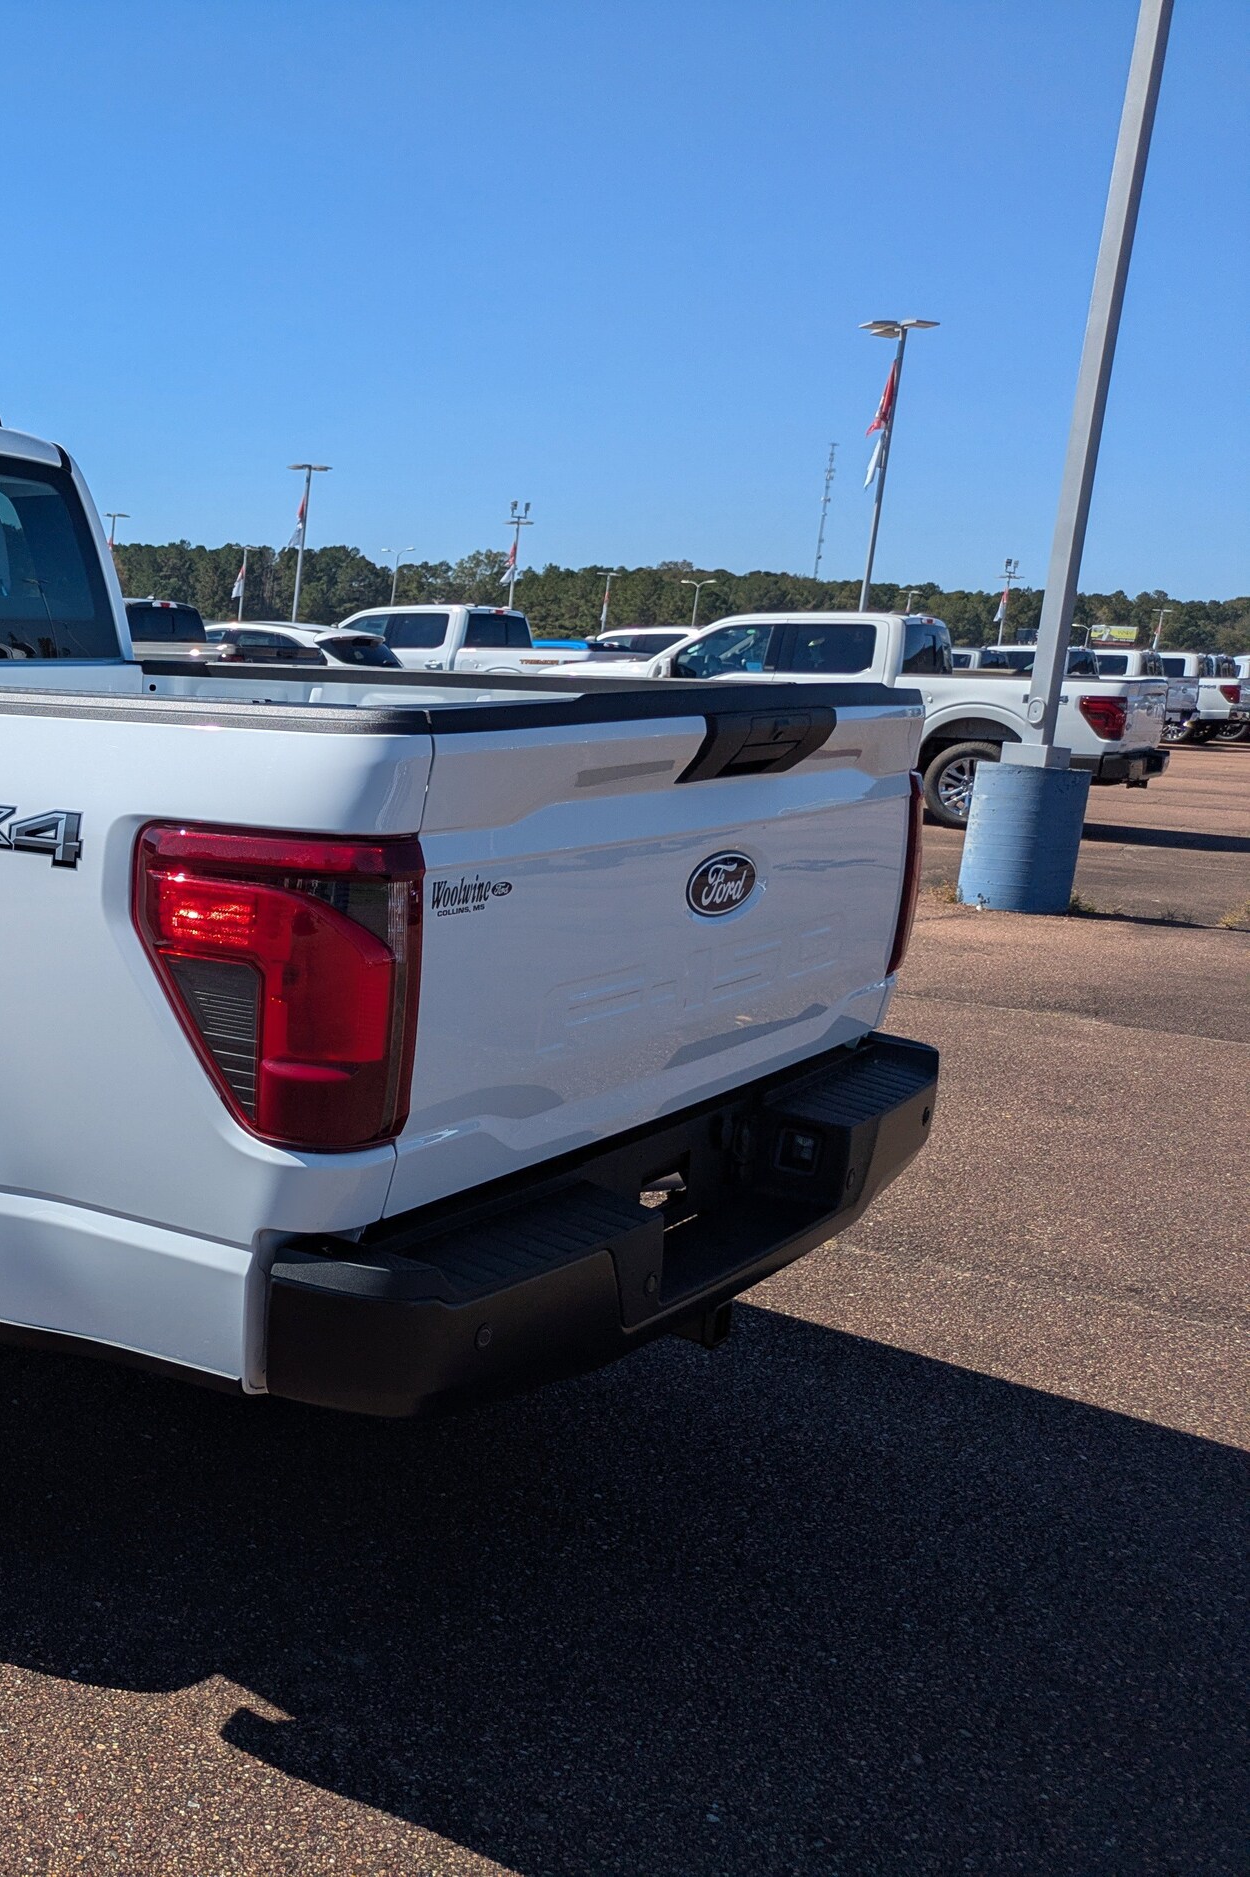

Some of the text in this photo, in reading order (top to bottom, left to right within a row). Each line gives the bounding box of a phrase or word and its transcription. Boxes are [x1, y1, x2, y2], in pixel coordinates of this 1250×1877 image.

[431, 874, 492, 910] Woolwine
[437, 904, 485, 917] COLLINS, MS
